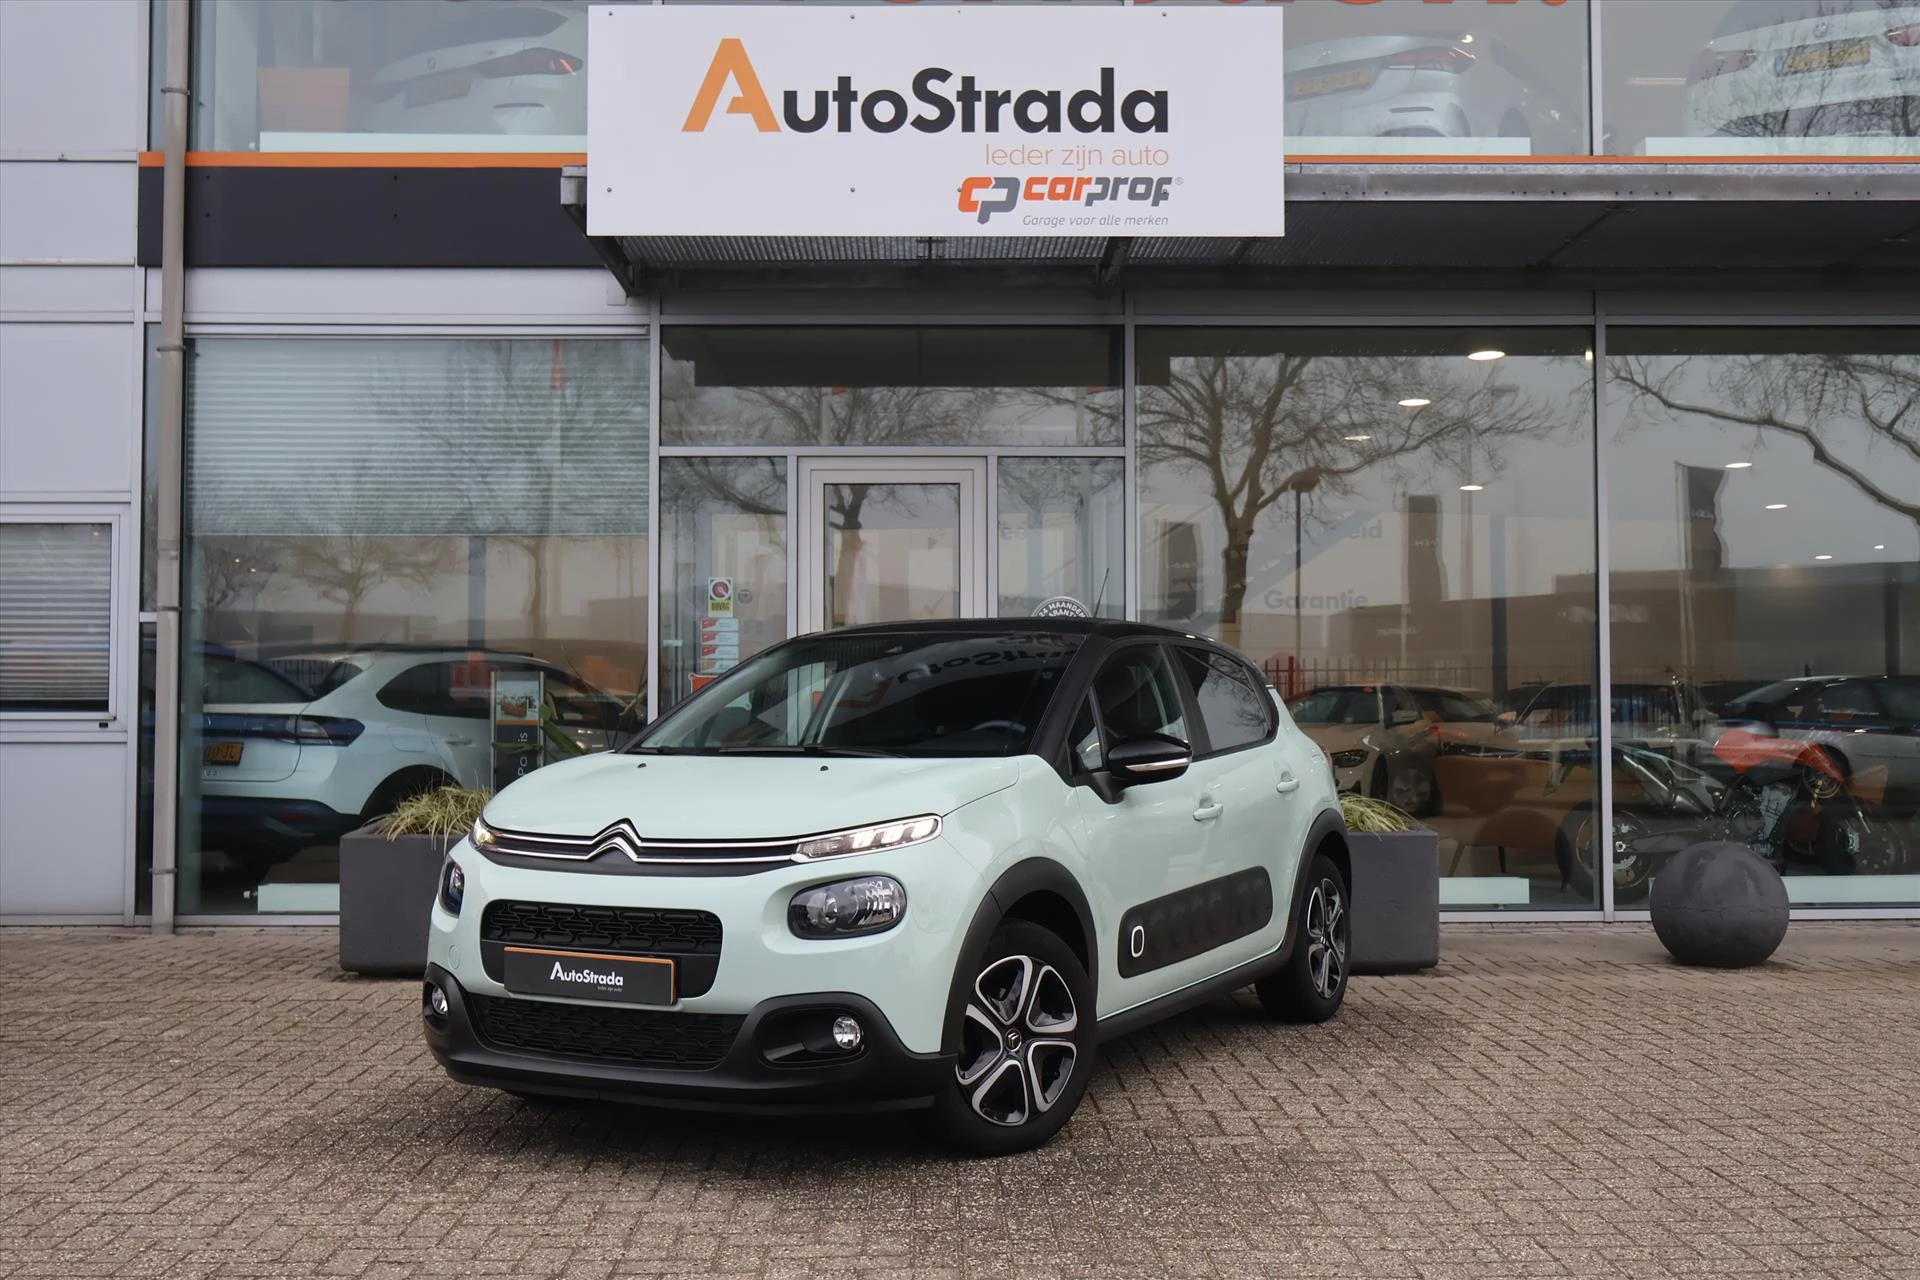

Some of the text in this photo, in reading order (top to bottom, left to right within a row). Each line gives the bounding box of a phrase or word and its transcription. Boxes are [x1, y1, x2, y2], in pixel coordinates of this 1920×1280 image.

[682, 38, 1168, 134] AutoStrada
[985, 143, 1169, 171] Ieder zijn auto
[1022, 215, 1169, 229] Garage voor alle merken
[1264, 589, 1368, 610] Garantie
[550, 961, 624, 986] AutoStrada
